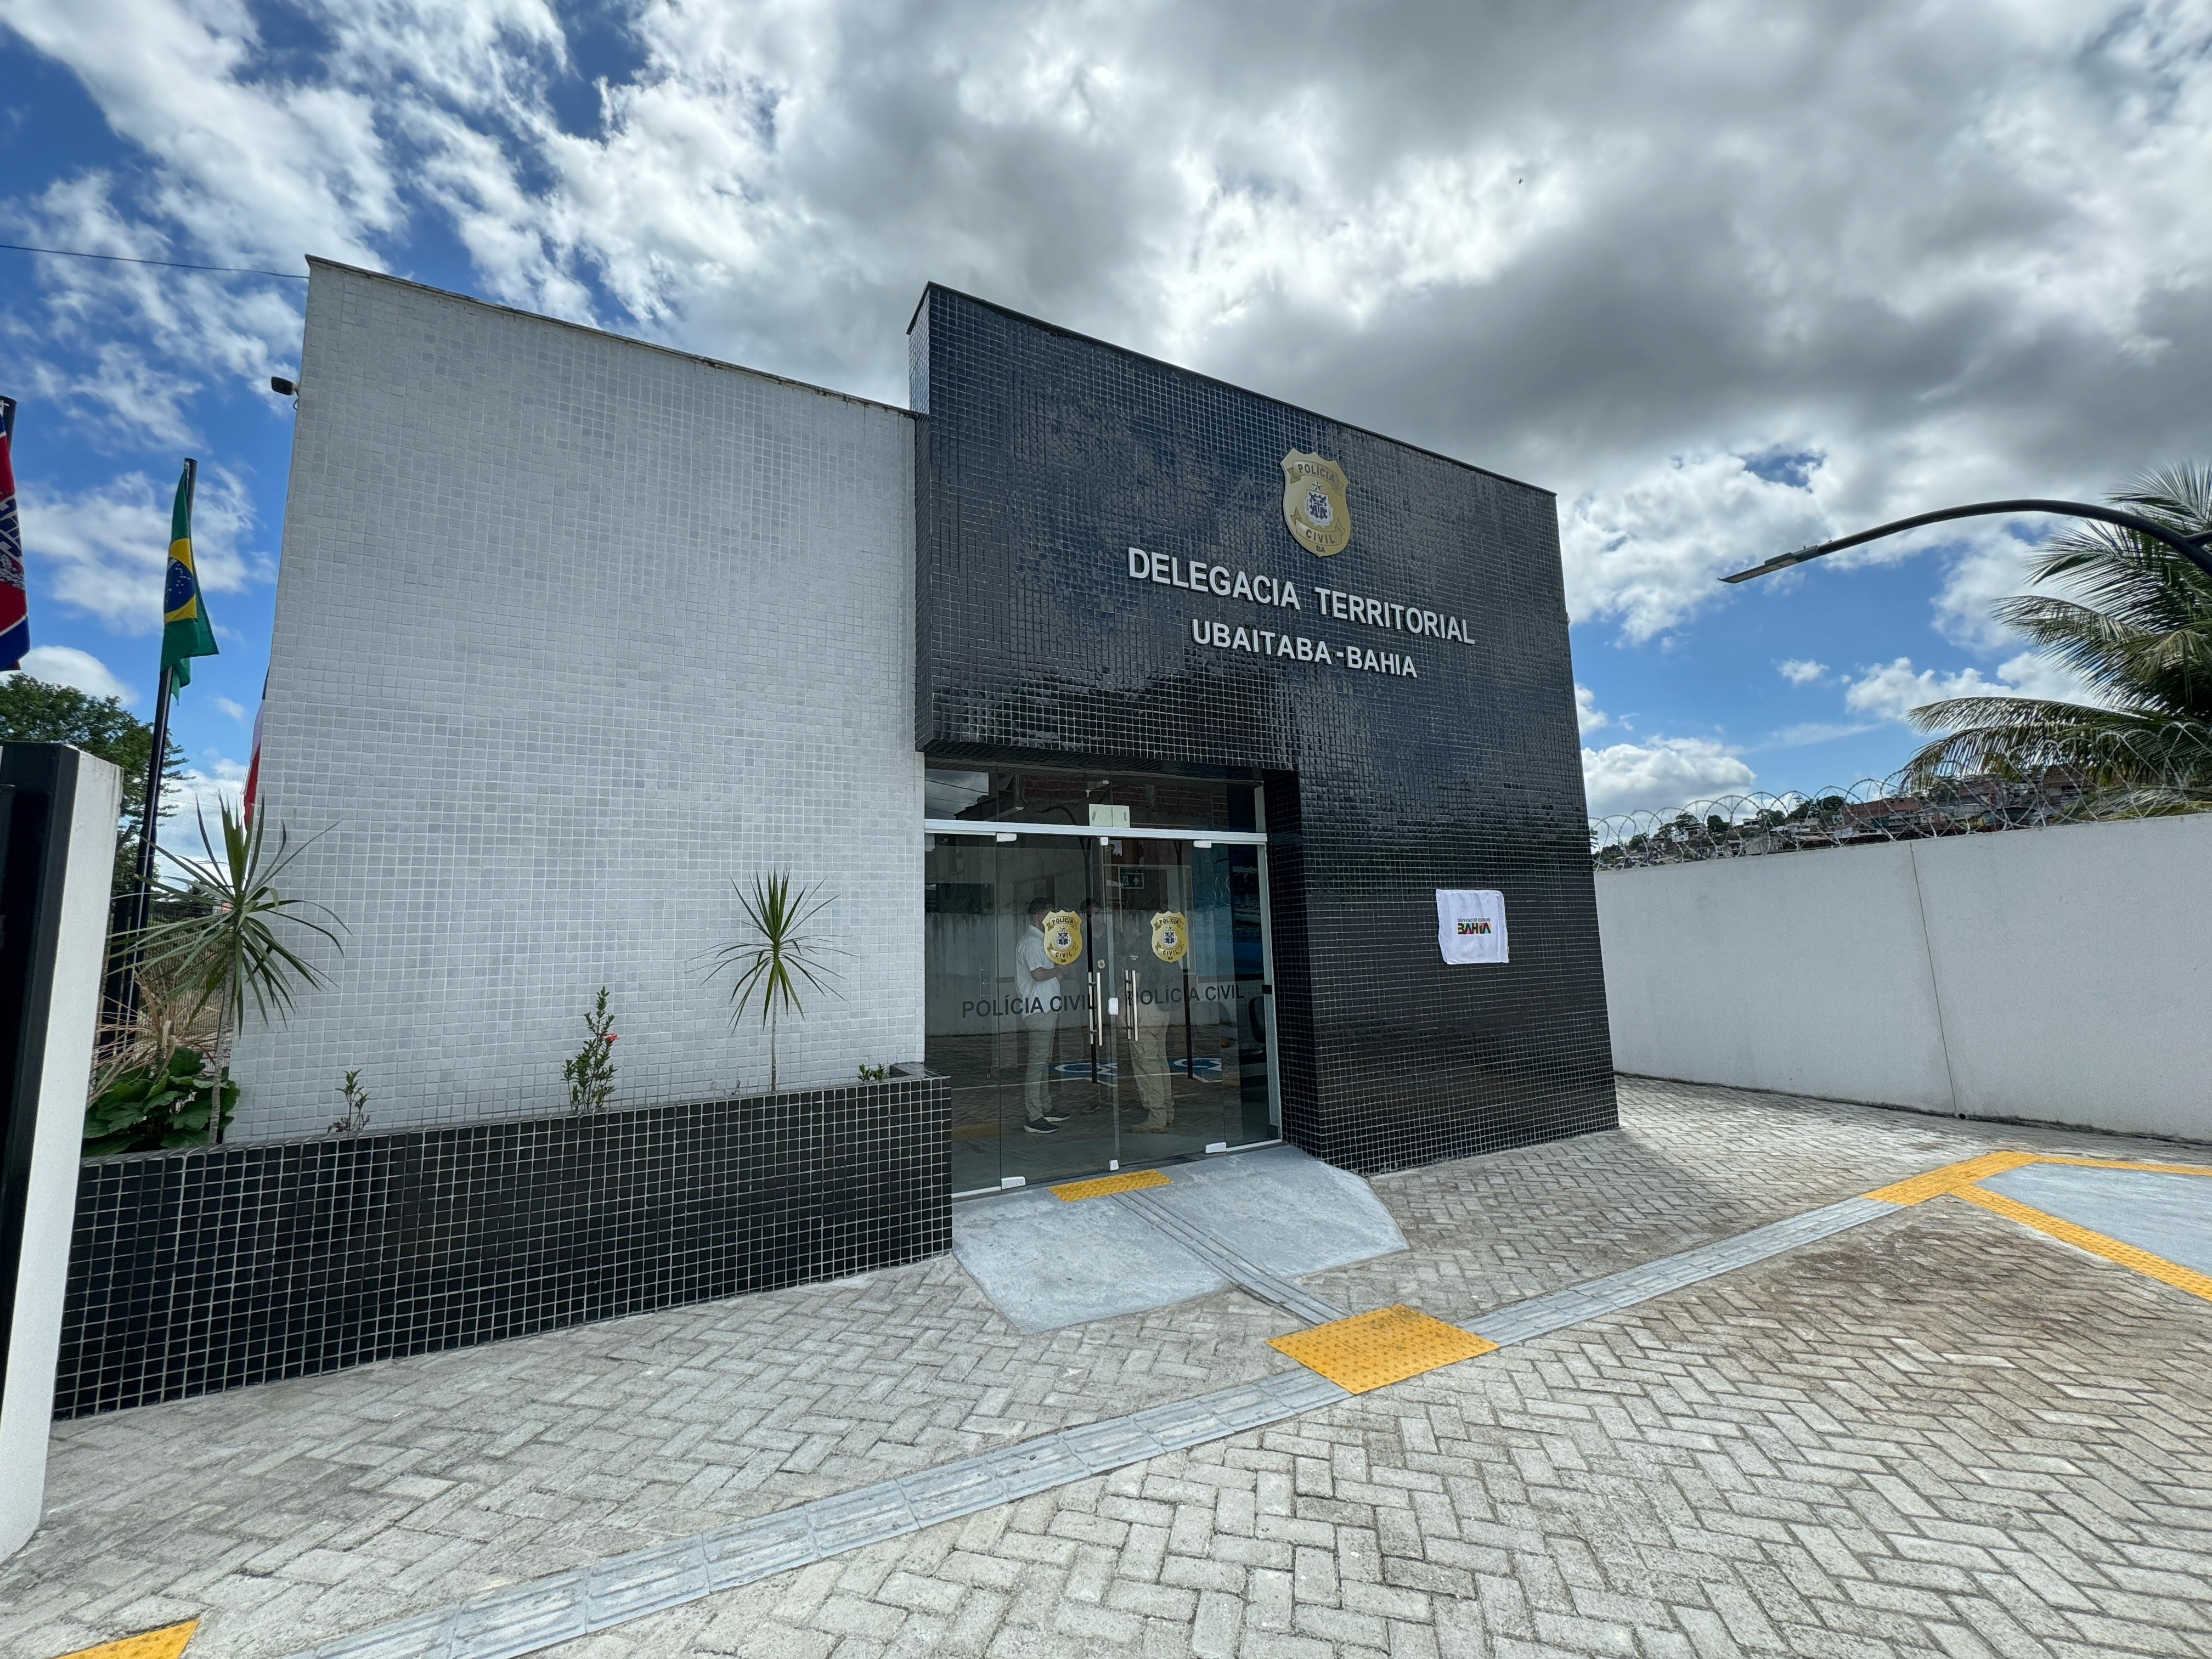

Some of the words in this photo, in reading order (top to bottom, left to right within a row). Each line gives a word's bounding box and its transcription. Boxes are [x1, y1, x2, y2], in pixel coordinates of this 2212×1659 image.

[1297, 463, 1335, 484] POLÍCIA
[1306, 529, 1335, 544] CIVIL
[1128, 547, 1301, 611] DELEGACIA
[1314, 586, 1476, 645] TERRITORIAL
[1192, 618, 1418, 679] UBAITABA-BAHIA
[1458, 922, 1491, 935] BAHIA
[962, 995, 1043, 1018] POLÍCIA
[1049, 994, 1096, 1012] CIVIL
[1127, 985, 1200, 1006] POLÍCA
[1205, 984, 1245, 1001] CIVIL
